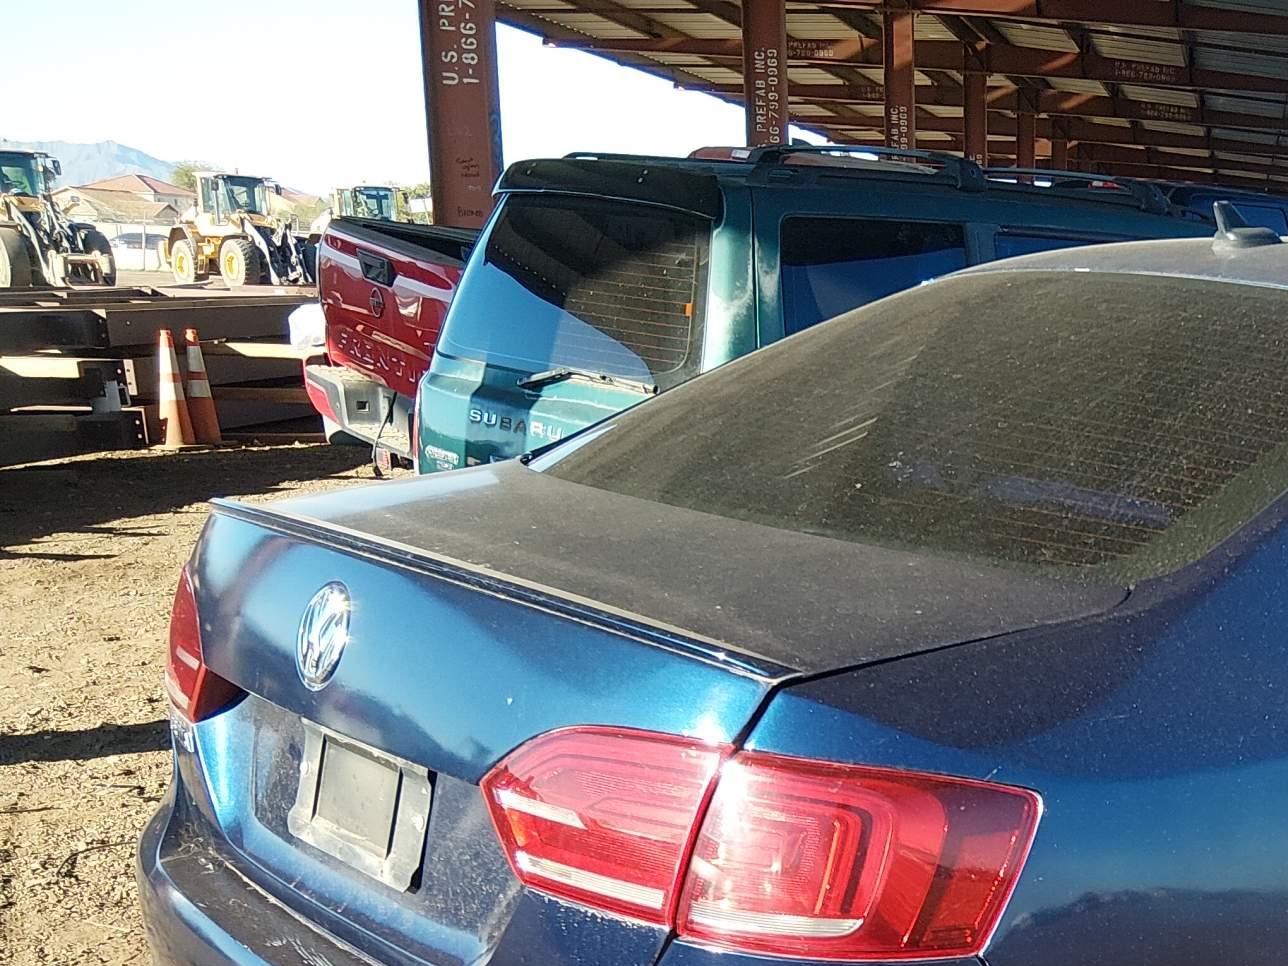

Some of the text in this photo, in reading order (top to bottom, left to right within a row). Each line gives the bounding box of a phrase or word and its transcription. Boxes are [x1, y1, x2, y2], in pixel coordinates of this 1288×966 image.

[438, 0, 459, 85] U.S. PR
[754, 47, 766, 73] INC.
[755, 79, 768, 132] PREFAB
[338, 332, 419, 384] FRONTI
[469, 408, 563, 441] SUBARU
